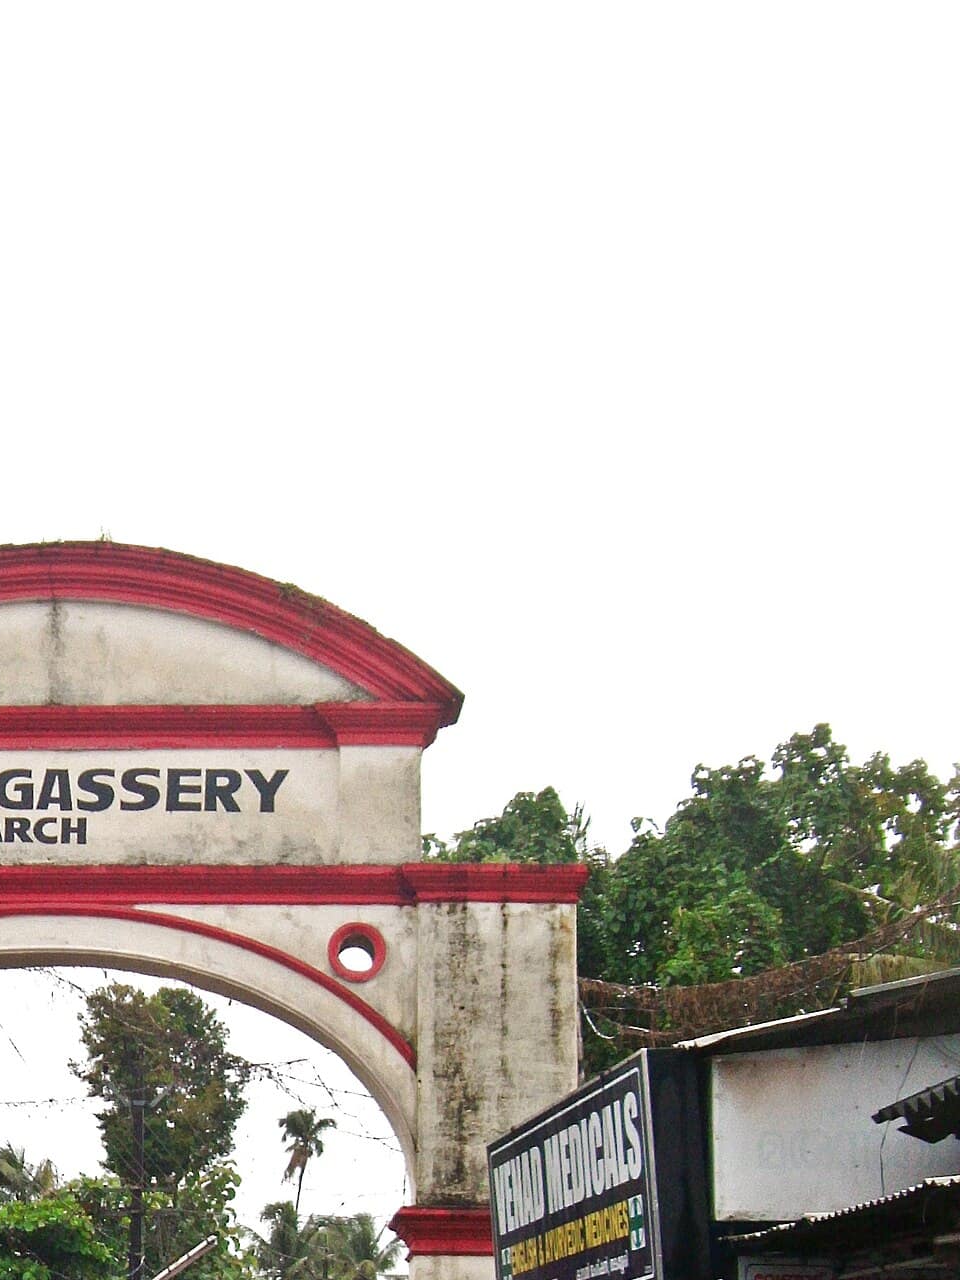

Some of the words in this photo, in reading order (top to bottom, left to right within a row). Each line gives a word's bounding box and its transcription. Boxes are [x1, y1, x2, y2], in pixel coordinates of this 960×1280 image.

[493, 1146, 545, 1236] VENAD
[544, 1091, 642, 1215] MEDICALS
[511, 1236, 537, 1276] ENGLISH
[545, 1217, 586, 1264] AYURVEDIC
[584, 1200, 630, 1249] MEDICINES
